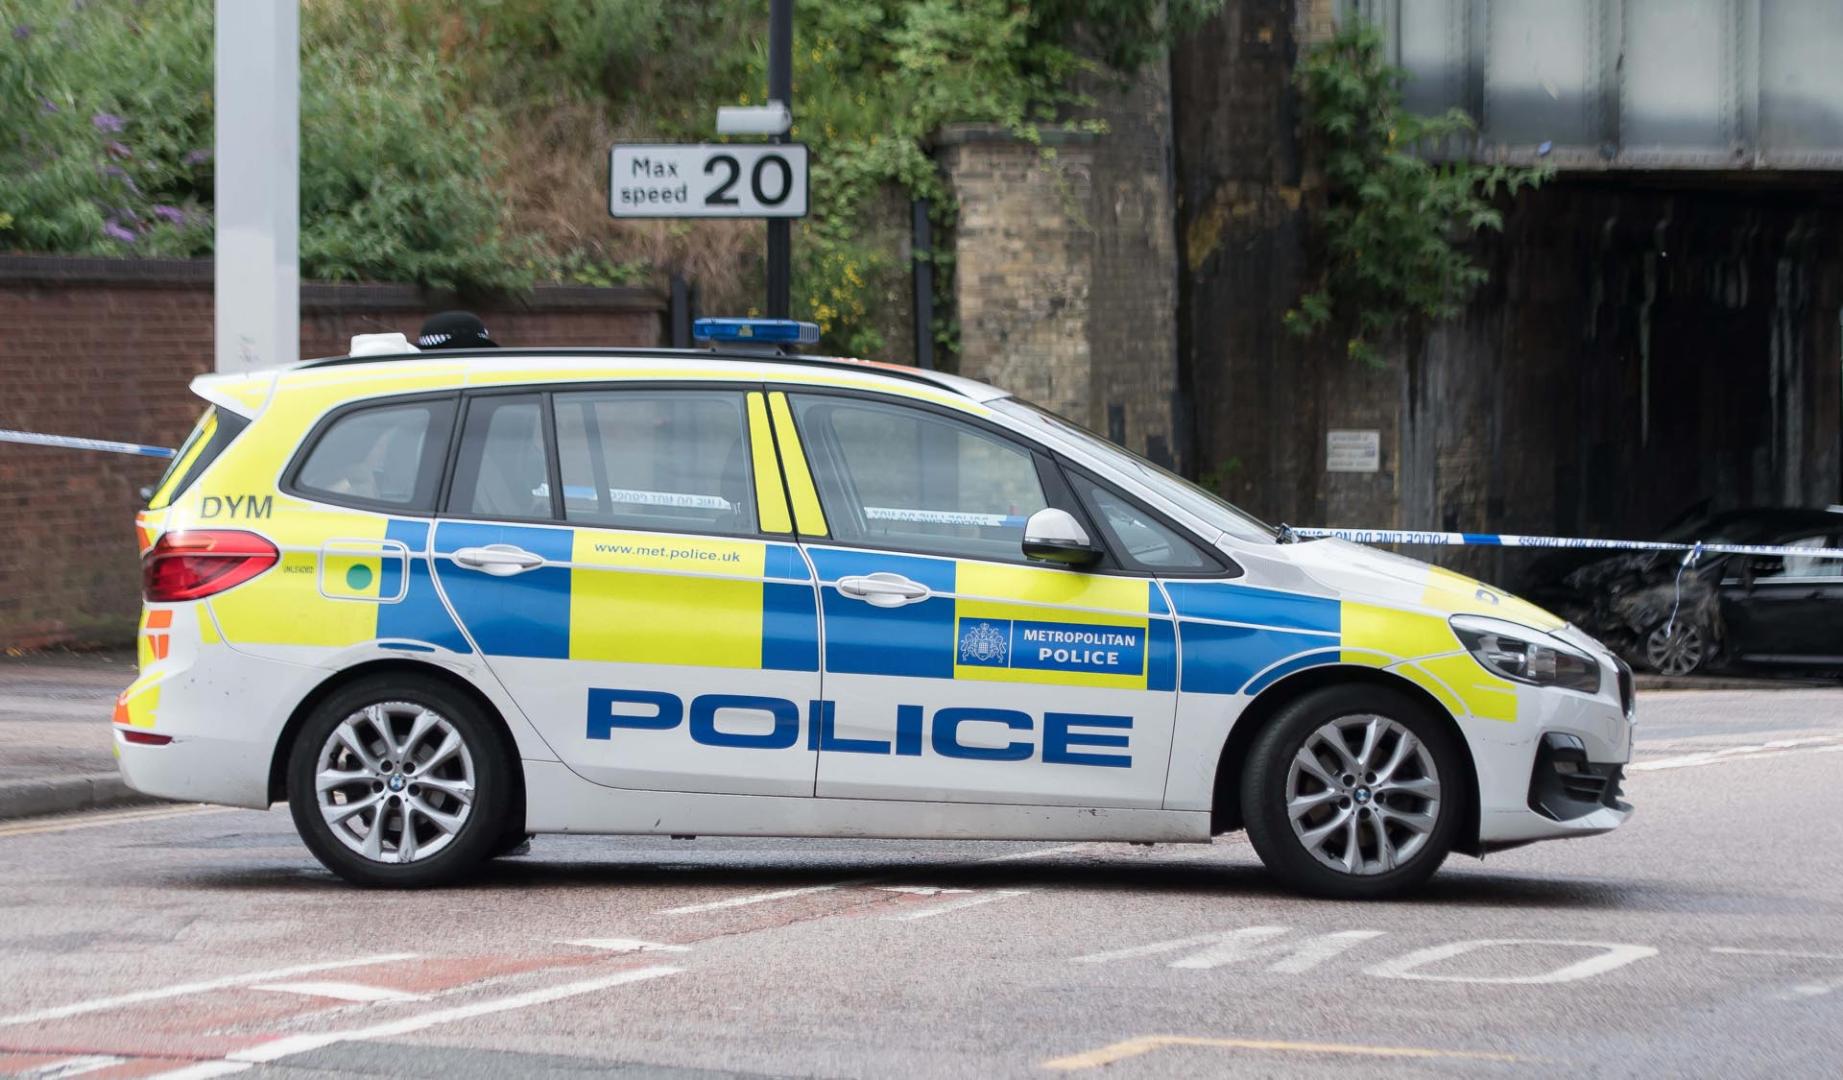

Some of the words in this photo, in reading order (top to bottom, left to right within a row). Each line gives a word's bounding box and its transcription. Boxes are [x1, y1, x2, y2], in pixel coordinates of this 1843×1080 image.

[631, 157, 678, 178] Max
[703, 154, 793, 208] 20
[620, 184, 688, 207] speed
[200, 495, 273, 519] DYM
[1376, 532, 1402, 544] LINE
[1406, 533, 1450, 545] POLICE
[594, 543, 741, 562] www.met.police.uk
[1023, 628, 1136, 647] METROPOLITAN
[1038, 647, 1119, 666] POLICE
[586, 687, 1134, 768] POLICE
